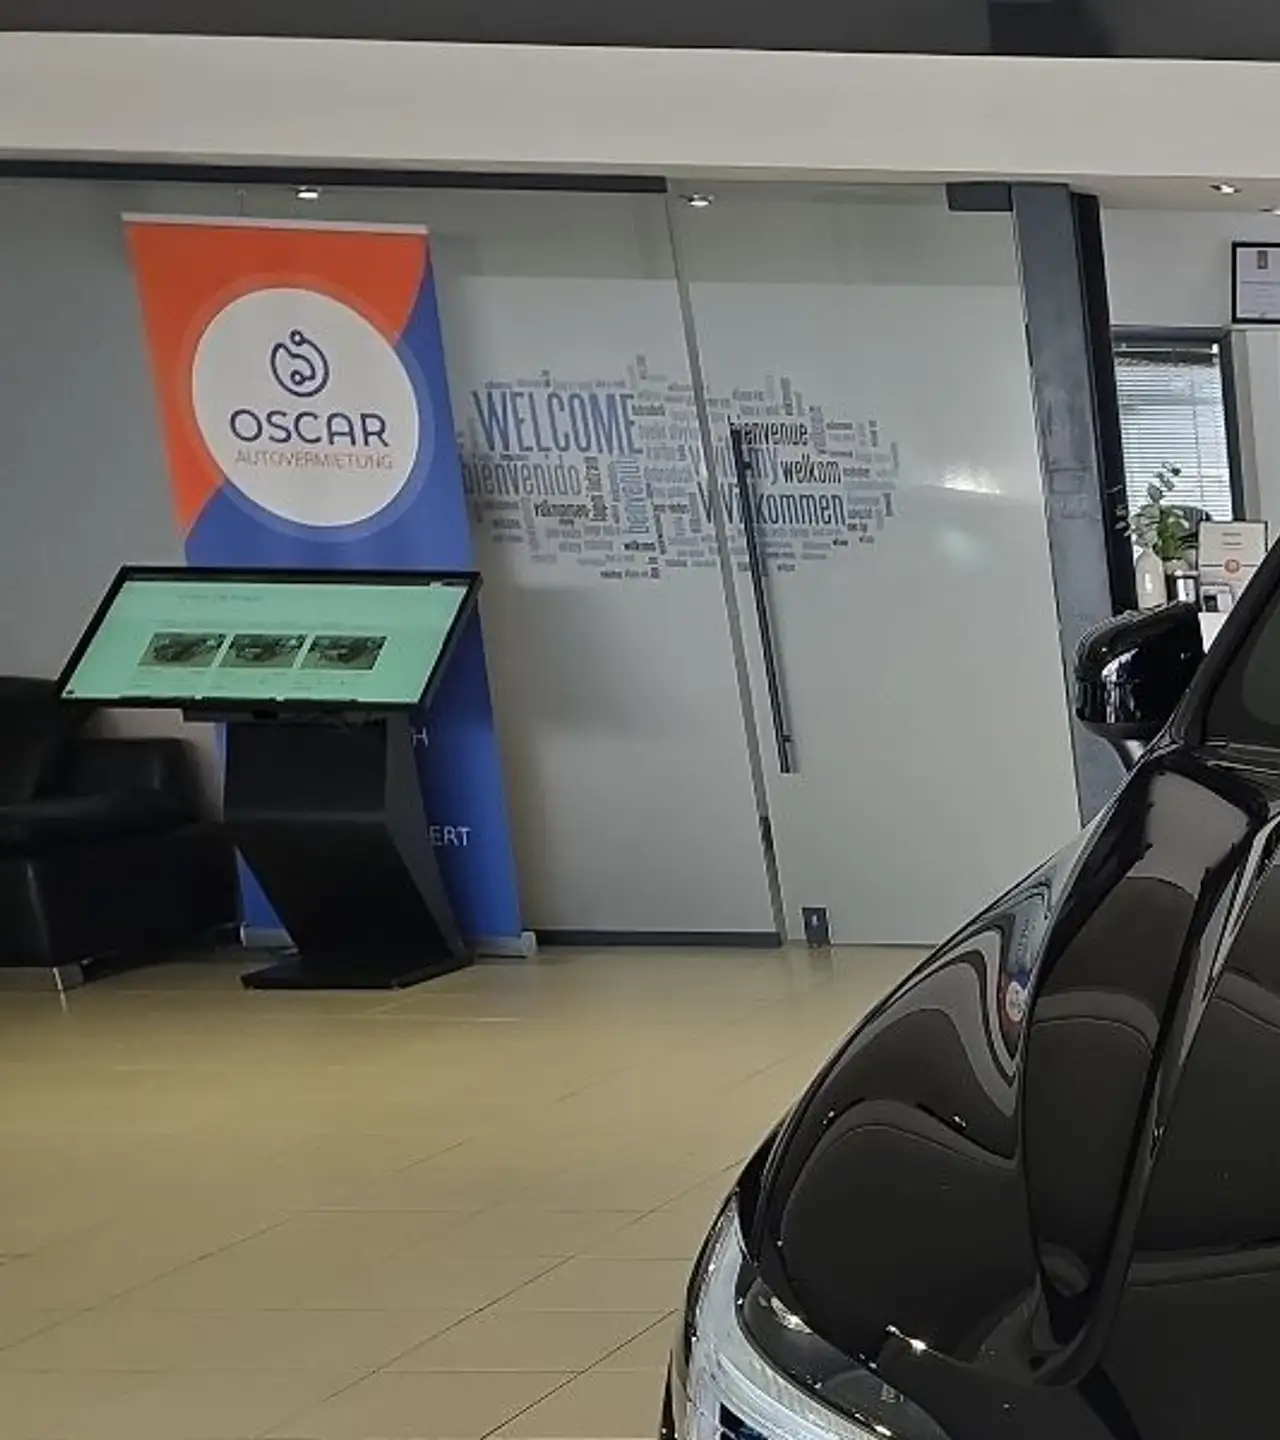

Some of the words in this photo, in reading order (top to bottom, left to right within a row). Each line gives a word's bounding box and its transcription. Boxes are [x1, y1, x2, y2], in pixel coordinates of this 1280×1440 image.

[229, 408, 390, 447] OSCAR
[471, 390, 644, 455] WELCOME
[234, 449, 394, 471] AUTOVERMIETUNG
[780, 452, 843, 485] welkom
